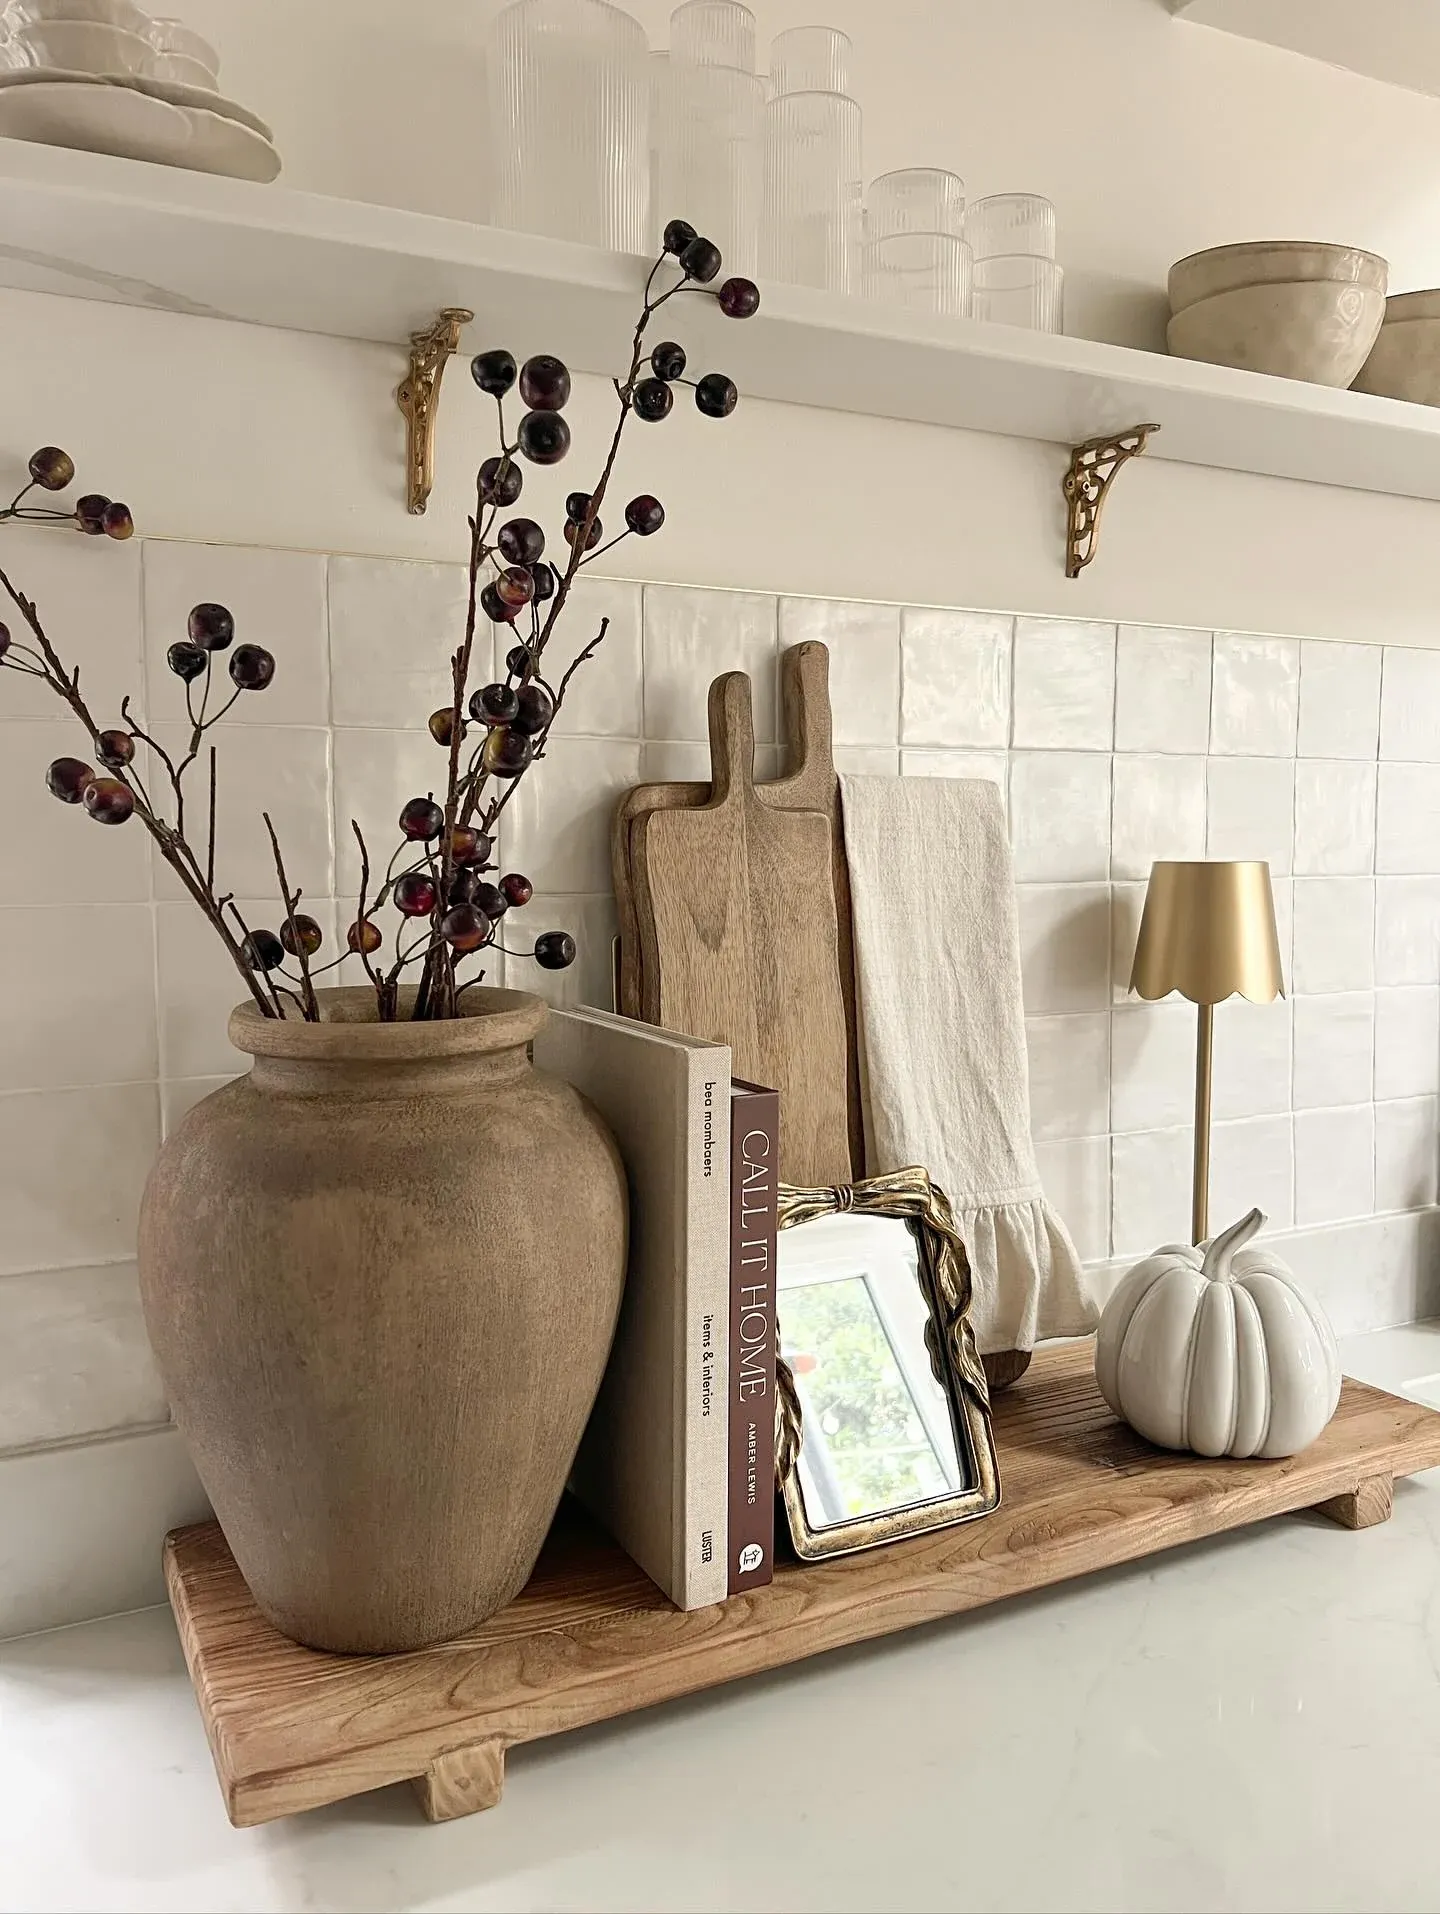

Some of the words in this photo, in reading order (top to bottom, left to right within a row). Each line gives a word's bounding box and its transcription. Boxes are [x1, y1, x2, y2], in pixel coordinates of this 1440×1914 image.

[704, 1081, 717, 1107] bea
[703, 1111, 716, 1178] mombaers
[741, 1130, 770, 1230] CALL
[741, 1238, 768, 1272] IT
[702, 1314, 714, 1348] items
[740, 1283, 768, 1403] HOME
[702, 1351, 714, 1363] &
[702, 1364, 714, 1417] interiors
[747, 1422, 757, 1464] AMBER
[747, 1467, 756, 1505] LEWIS
[701, 1530, 713, 1564] LUSTER
